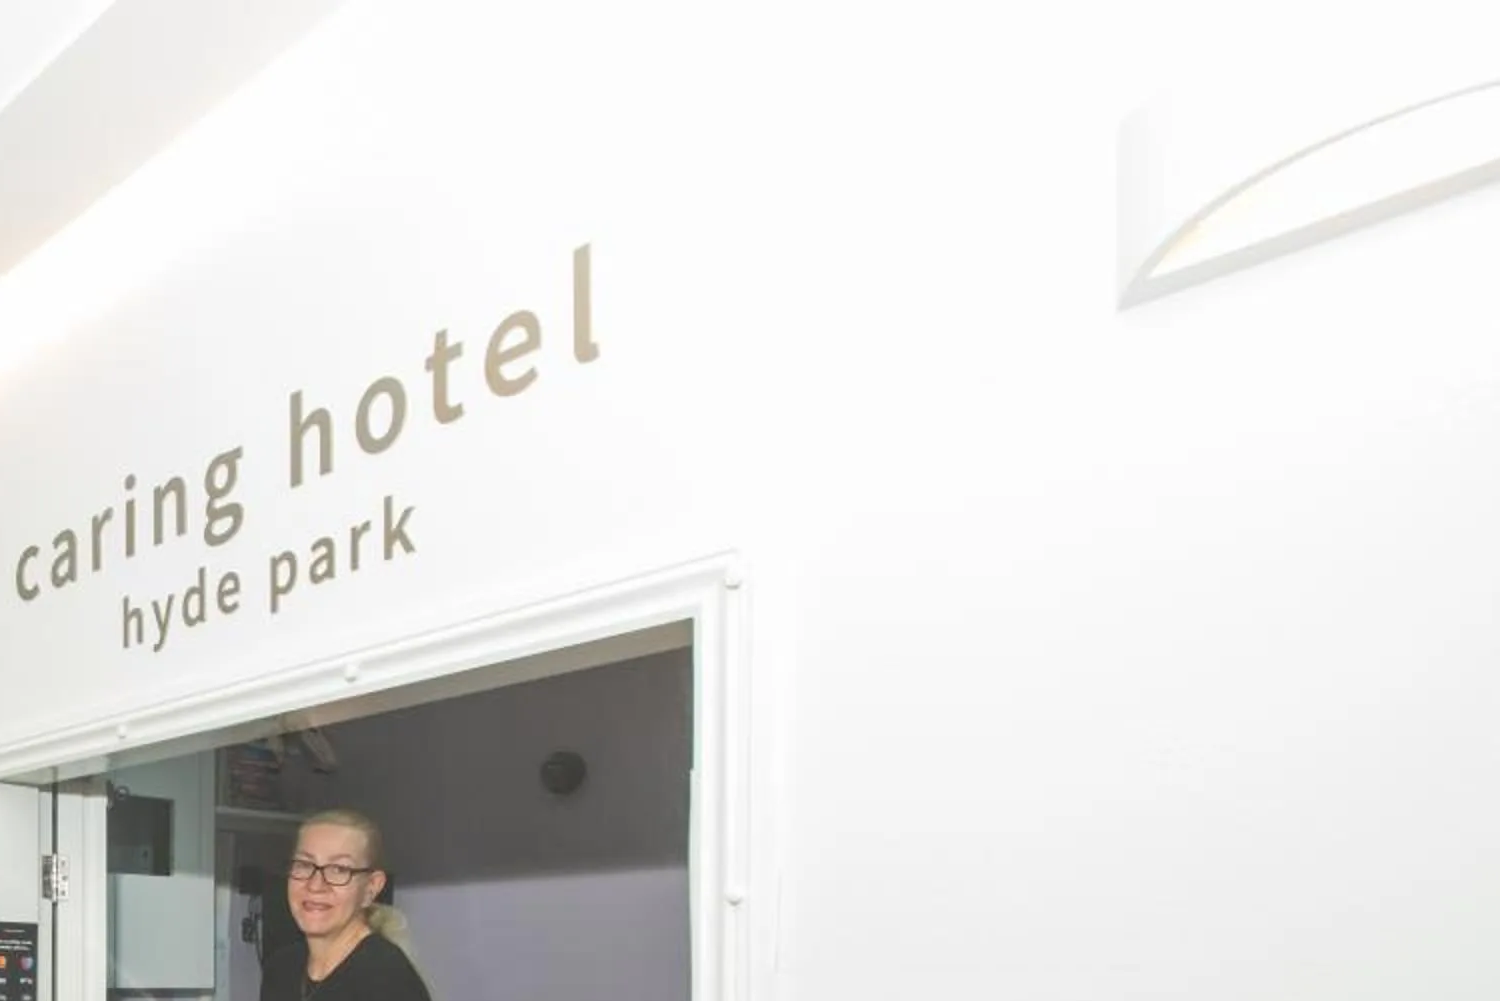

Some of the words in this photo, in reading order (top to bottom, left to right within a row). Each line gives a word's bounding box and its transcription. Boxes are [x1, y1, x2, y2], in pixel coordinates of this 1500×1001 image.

[15, 446, 244, 603] caring
[289, 243, 599, 489] hotel
[122, 566, 241, 654] hyde
[269, 495, 416, 615] park
